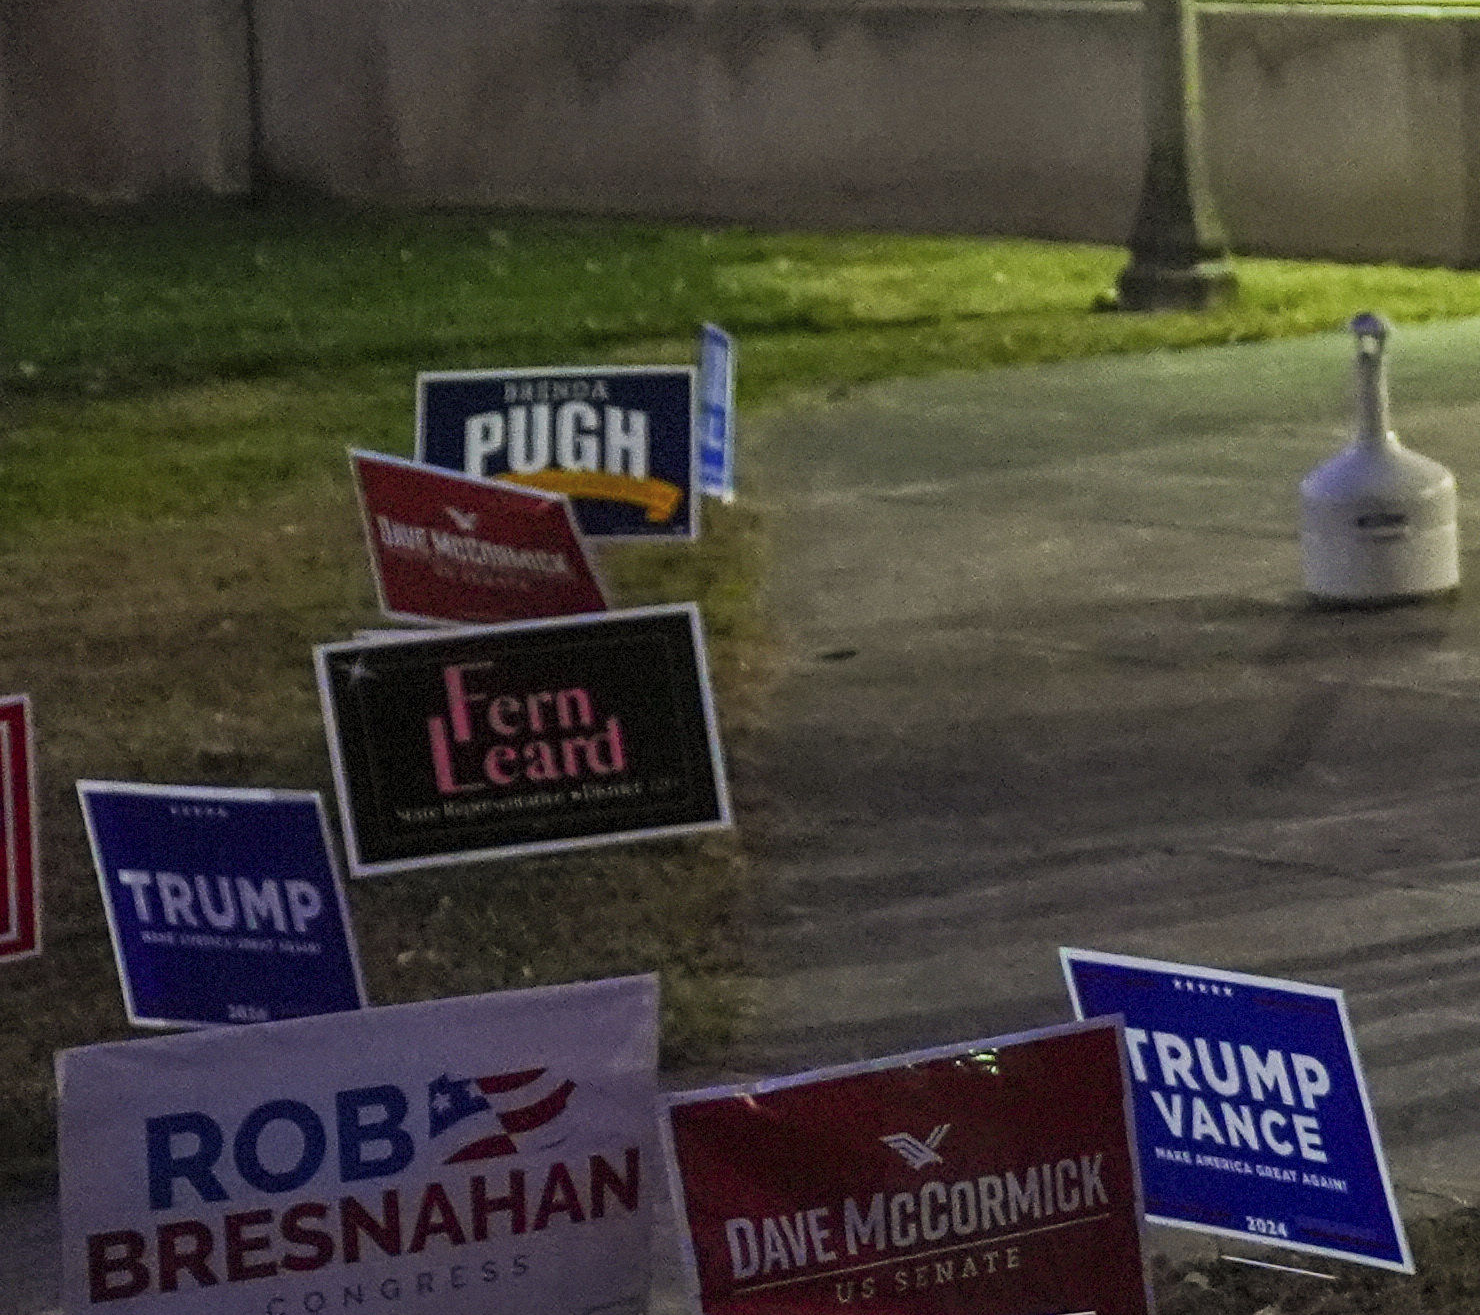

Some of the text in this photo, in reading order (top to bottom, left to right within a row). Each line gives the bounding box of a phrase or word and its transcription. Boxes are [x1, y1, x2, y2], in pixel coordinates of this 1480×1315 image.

[463, 400, 648, 482] PUGH
[443, 660, 592, 743] Fern
[428, 715, 626, 795] Leard
[117, 868, 323, 933] TRUMP
[1126, 1027, 1331, 1111] TRUMP
[144, 1084, 416, 1212] ROB
[1151, 1090, 1329, 1164] VANCE
[86, 1146, 641, 1305] BRESNAHAN
[725, 1204, 834, 1281] DAVE
[1244, 1214, 1290, 1240] 2024
[836, 1245, 1021, 1305] US SENATE
